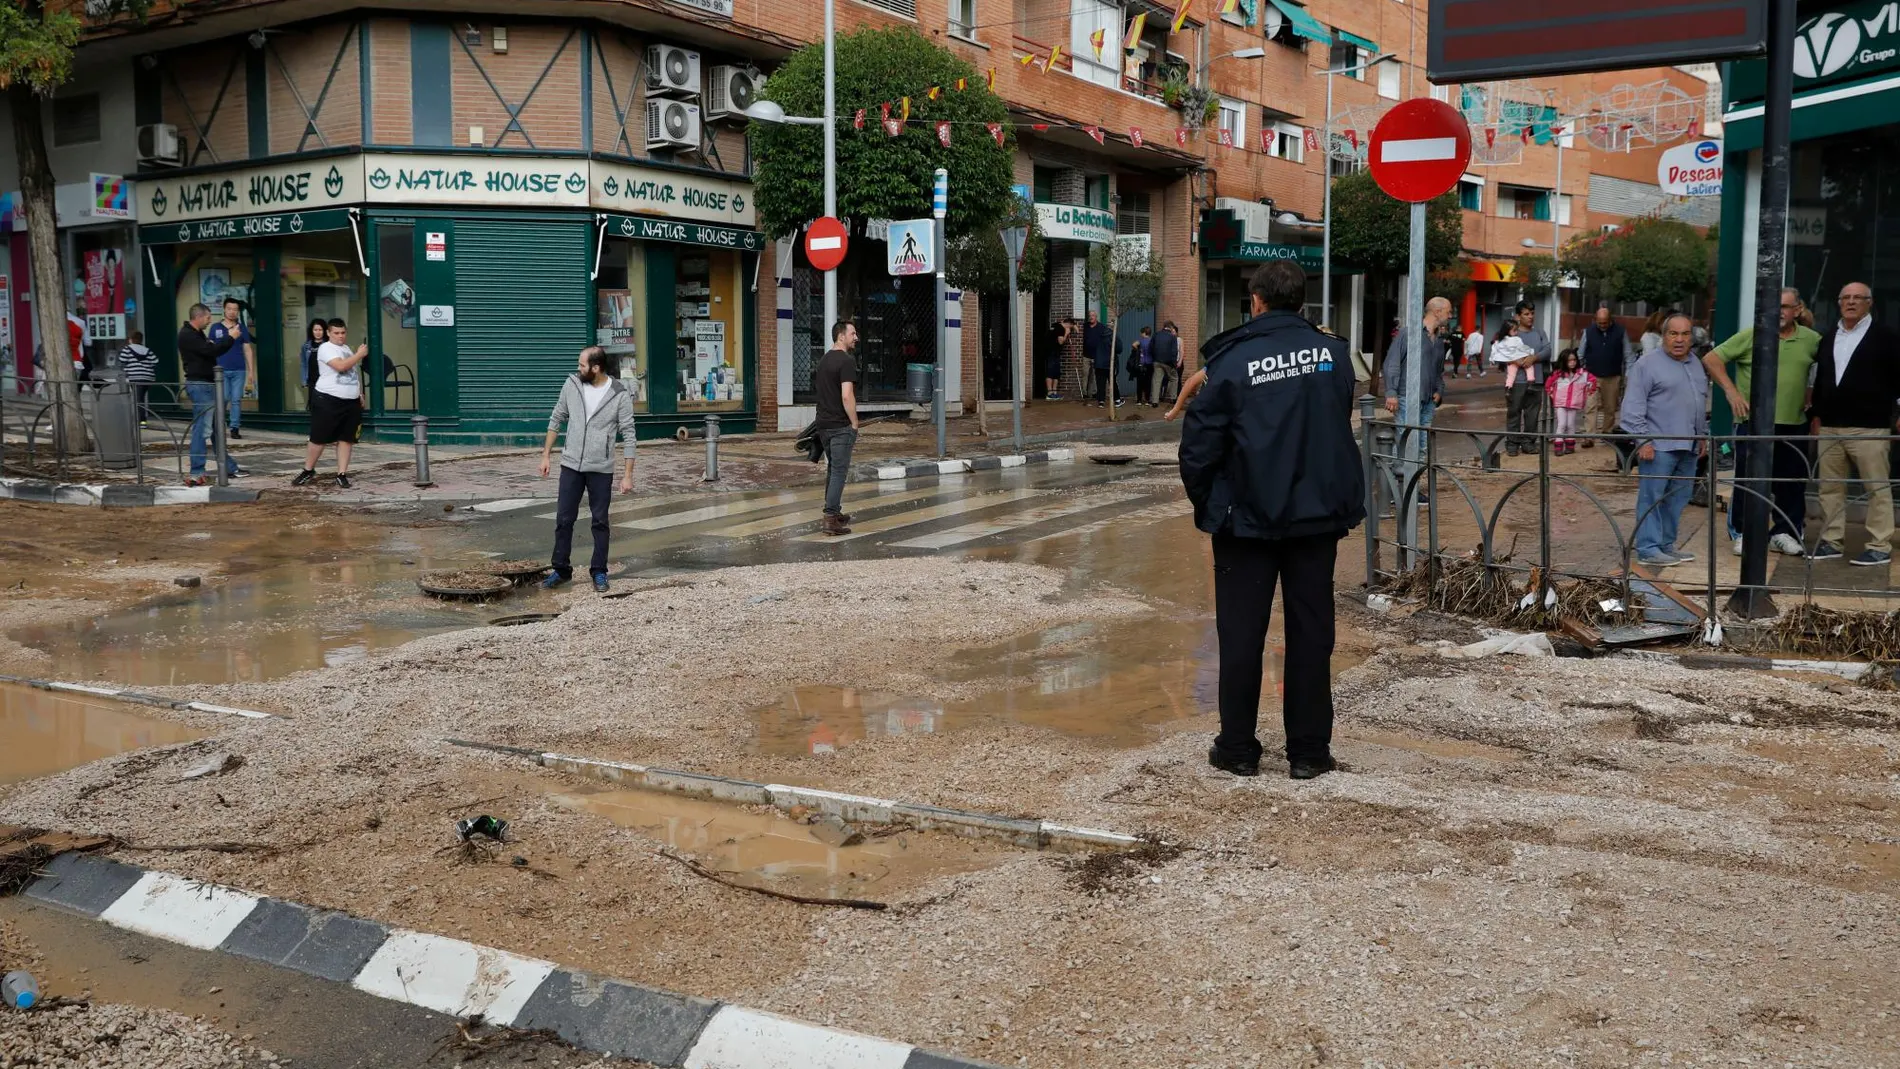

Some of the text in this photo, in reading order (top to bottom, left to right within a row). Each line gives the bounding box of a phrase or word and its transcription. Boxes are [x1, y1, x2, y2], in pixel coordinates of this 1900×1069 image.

[1862, 2, 1900, 38] VI
[1860, 49, 1896, 63] Grupo
[396, 168, 560, 192] NATUR HOUSE
[178, 172, 311, 213] NATUR HOUSE
[624, 178, 728, 210] NATUR HOUSE
[198, 217, 282, 238] NATUR HOUSE
[1056, 207, 1070, 224] La
[1072, 208, 1102, 228] Botica
[642, 220, 736, 245] NATUR HOUSE
[1240, 245, 1298, 259] FARMACIA
[1247, 347, 1333, 376] POLICIA
[1251, 369, 1286, 386] ARGANDA
[1286, 367, 1301, 378] DEL
[1301, 364, 1317, 374] REY
